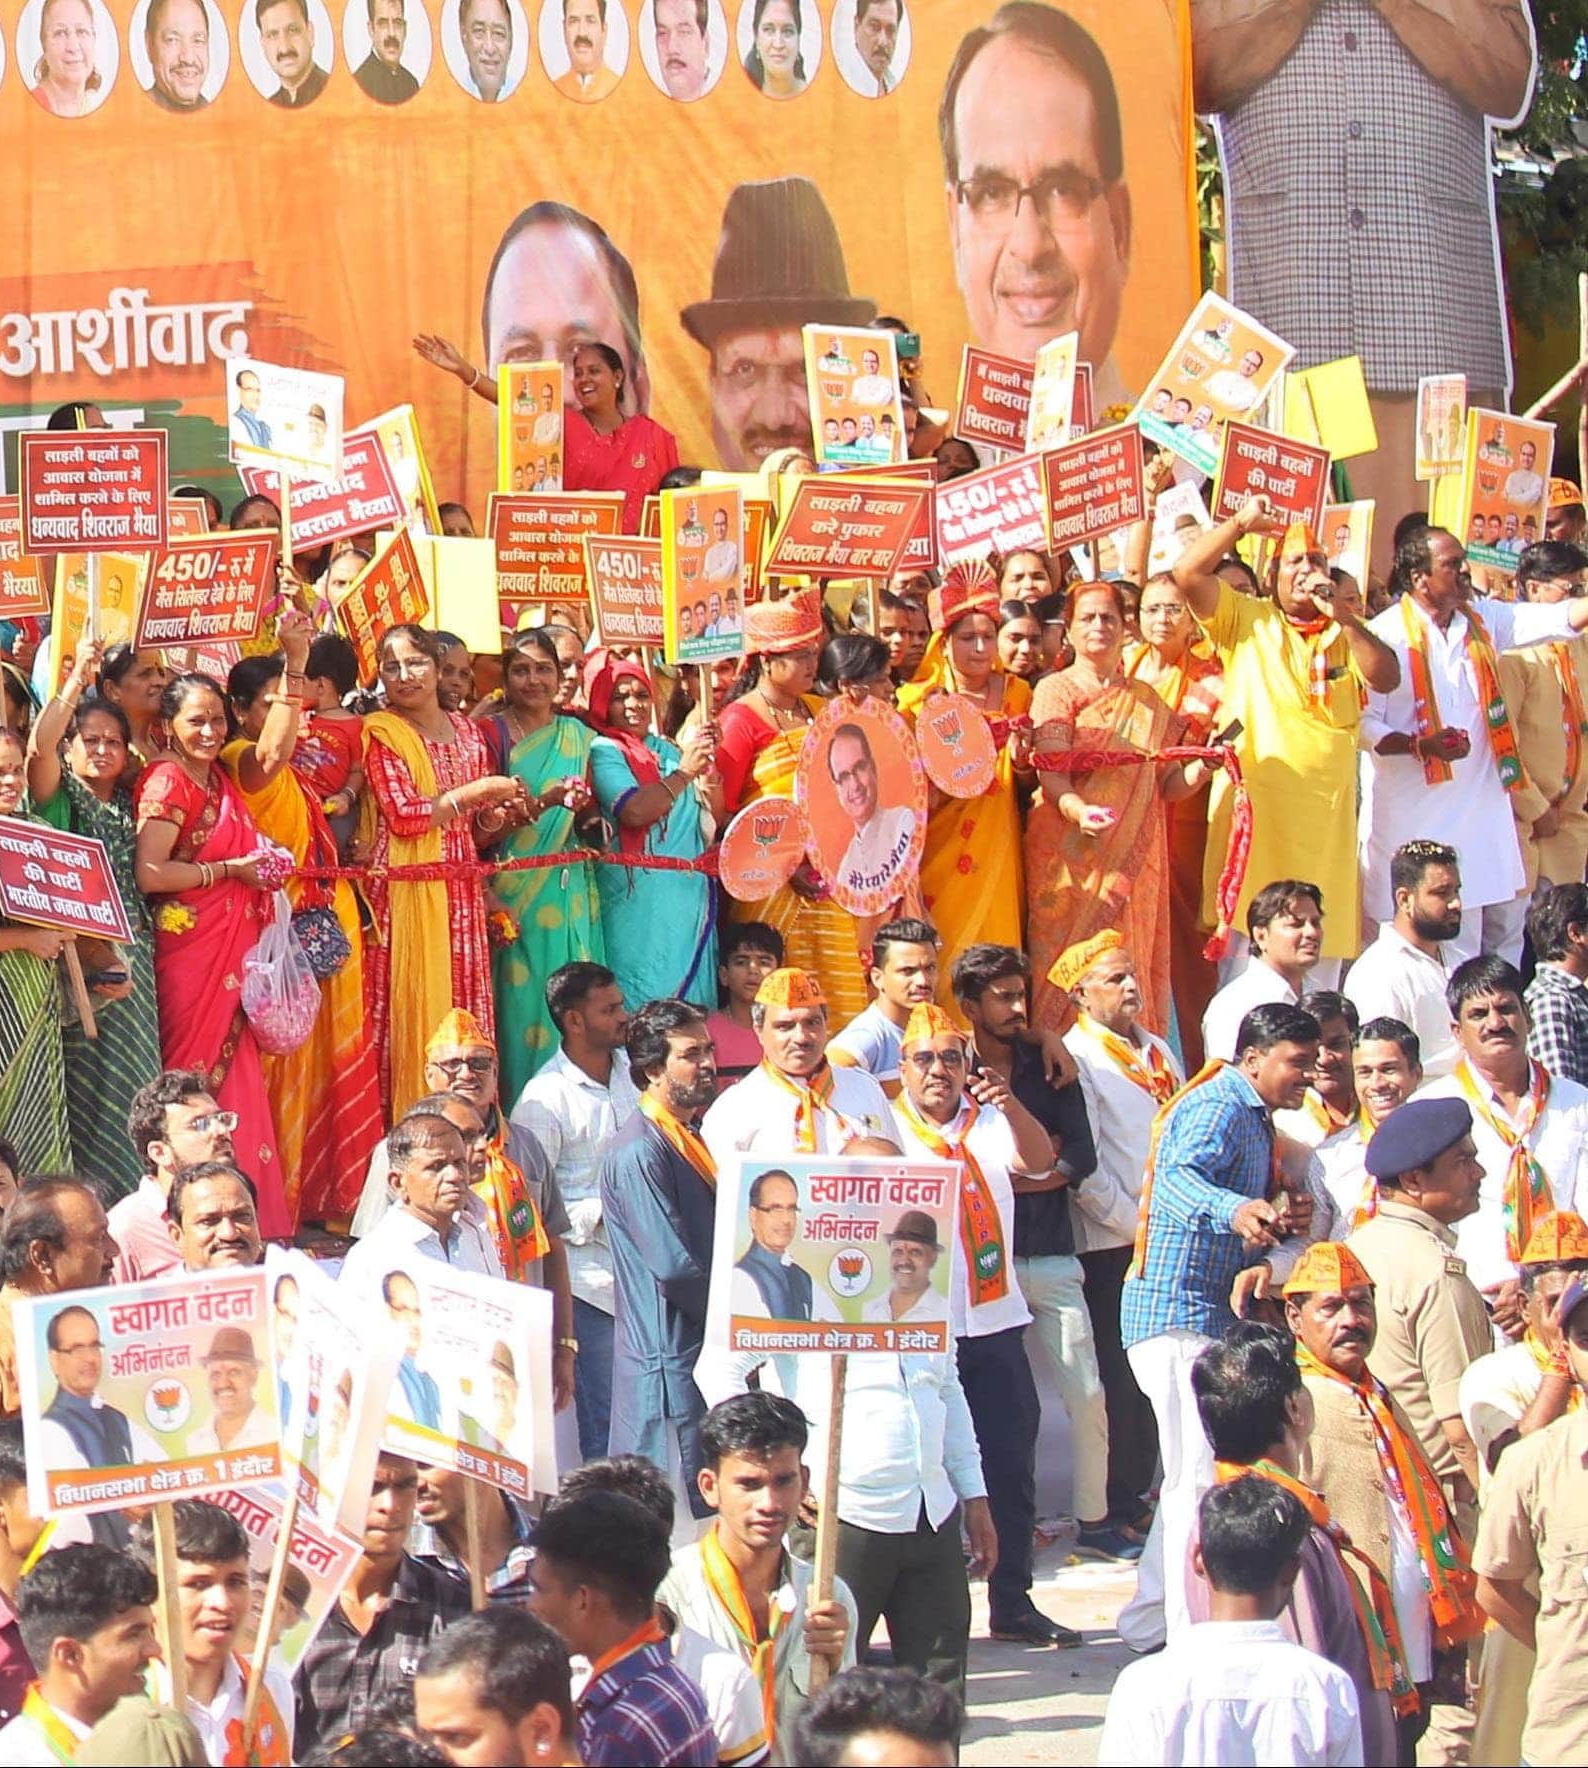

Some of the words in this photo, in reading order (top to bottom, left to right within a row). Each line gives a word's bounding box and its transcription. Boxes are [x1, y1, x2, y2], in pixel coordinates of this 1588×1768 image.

[157, 551, 226, 581] 450/-
[598, 551, 650, 580] 450/-
[51, 848, 92, 870] बहनों
[22, 862, 46, 884] की
[47, 871, 83, 892] पार्टी
[7, 884, 52, 913] भारतीय
[51, 895, 88, 921] जनता
[89, 900, 116, 926] पार्टी
[810, 1176, 883, 1205] स्वागत
[888, 1170, 944, 1205] वंदन
[803, 1213, 879, 1242] अभिनंदन
[109, 1297, 188, 1335] स्वागत
[194, 1286, 254, 1321] वंदन
[735, 1328, 820, 1348] विधानसभा
[824, 1329, 854, 1348] क्षेत्र
[885, 1330, 893, 1347] 1
[899, 1330, 940, 1349] इंदौर
[111, 1343, 191, 1376] अभिनंदन
[54, 1477, 146, 1505] विधानसभा
[150, 1470, 181, 1490] क्षेत्र
[215, 1461, 226, 1480] 1
[232, 1455, 274, 1479] इंदौर
